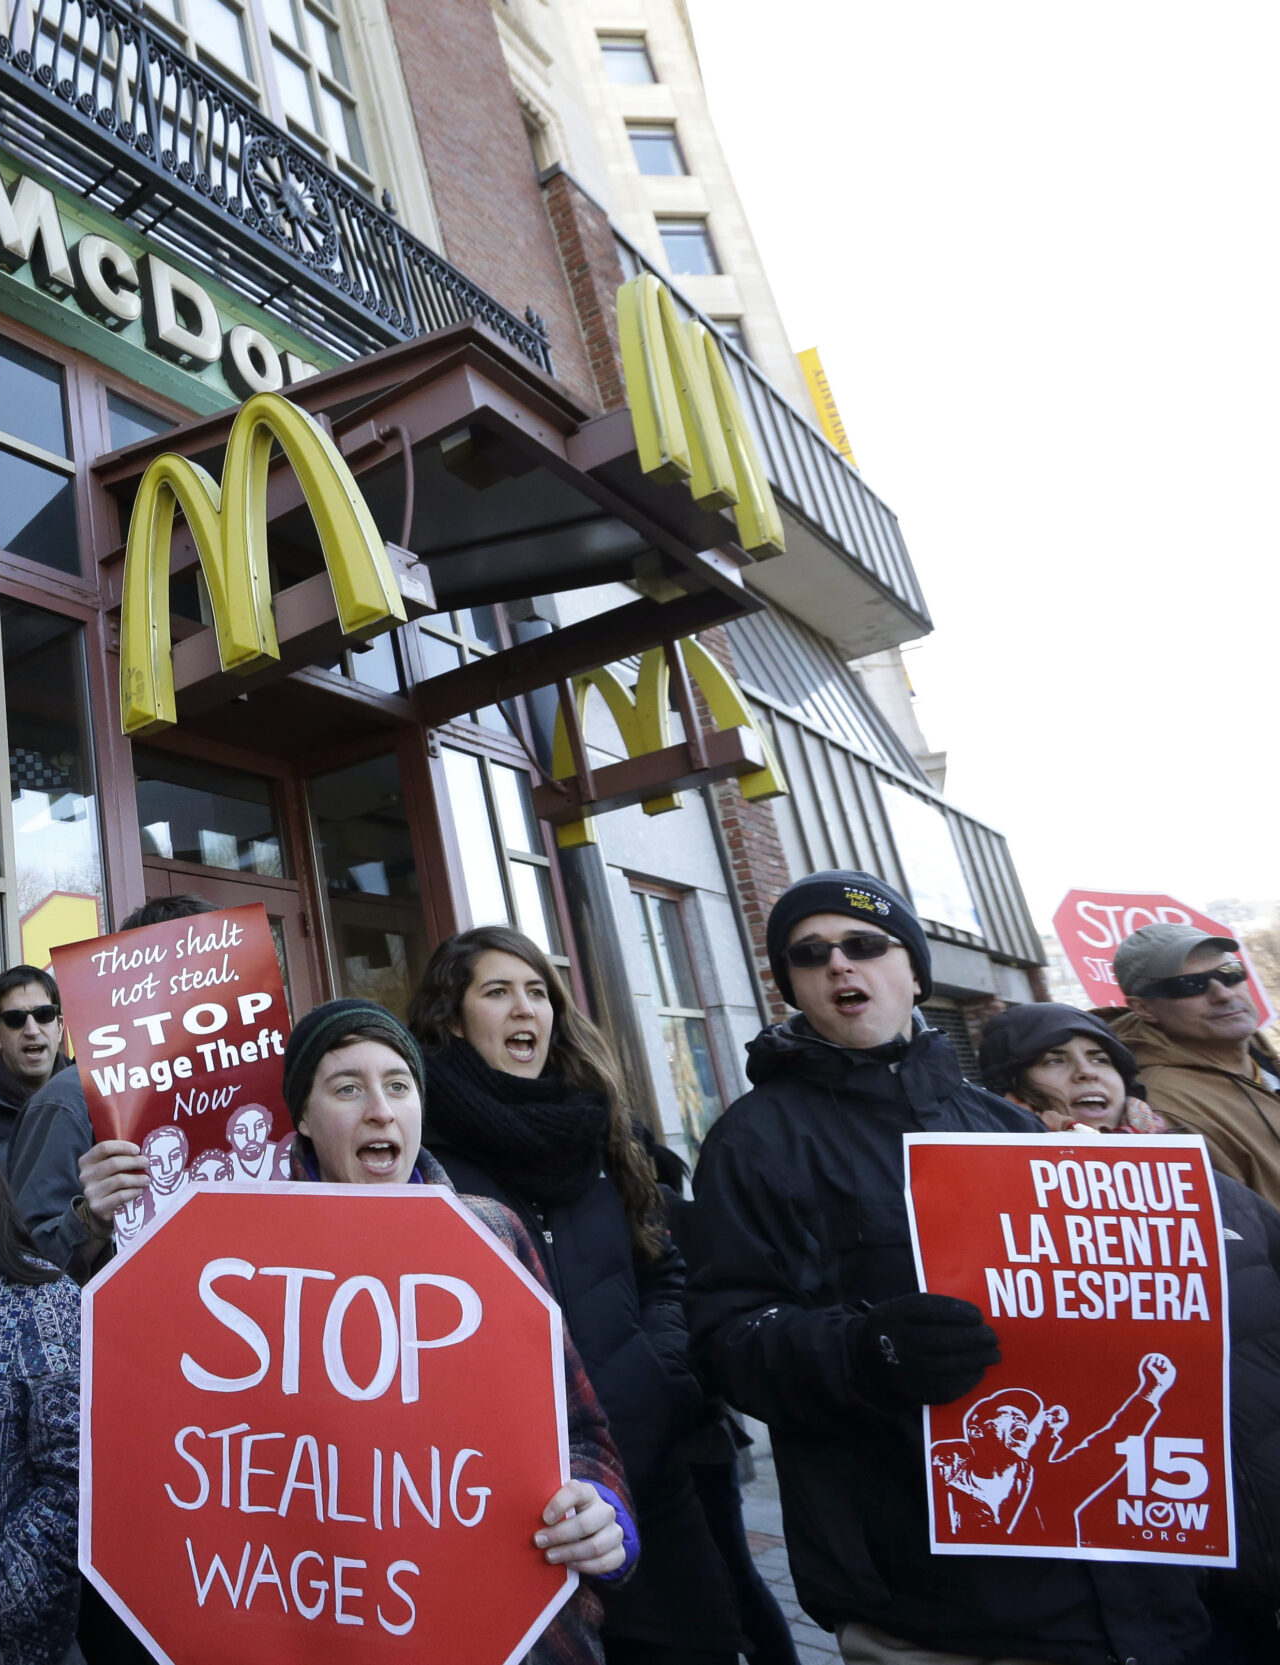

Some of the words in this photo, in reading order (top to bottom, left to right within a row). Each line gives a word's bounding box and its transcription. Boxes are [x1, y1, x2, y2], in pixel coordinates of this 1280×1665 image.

[91, 946, 168, 977] Thou
[175, 919, 244, 959] shalt
[111, 972, 160, 1008] not
[169, 953, 240, 995] steal.
[87, 992, 273, 1060] STOP
[90, 1054, 193, 1097] Wage
[196, 1028, 286, 1073] Theft
[173, 1082, 242, 1121] Now
[1029, 1159, 1200, 1213] PORQUE
[999, 1213, 1060, 1264] LA
[1064, 1214, 1209, 1267] RENTA
[984, 1267, 1046, 1320] NO
[1052, 1270, 1211, 1322] ESPERA
[179, 1256, 483, 1404] STOP
[164, 1423, 492, 1531] STEALING
[1115, 1435, 1209, 1499] 15
[1117, 1498, 1210, 1531] NOW
[186, 1537, 421, 1636] WAGES
